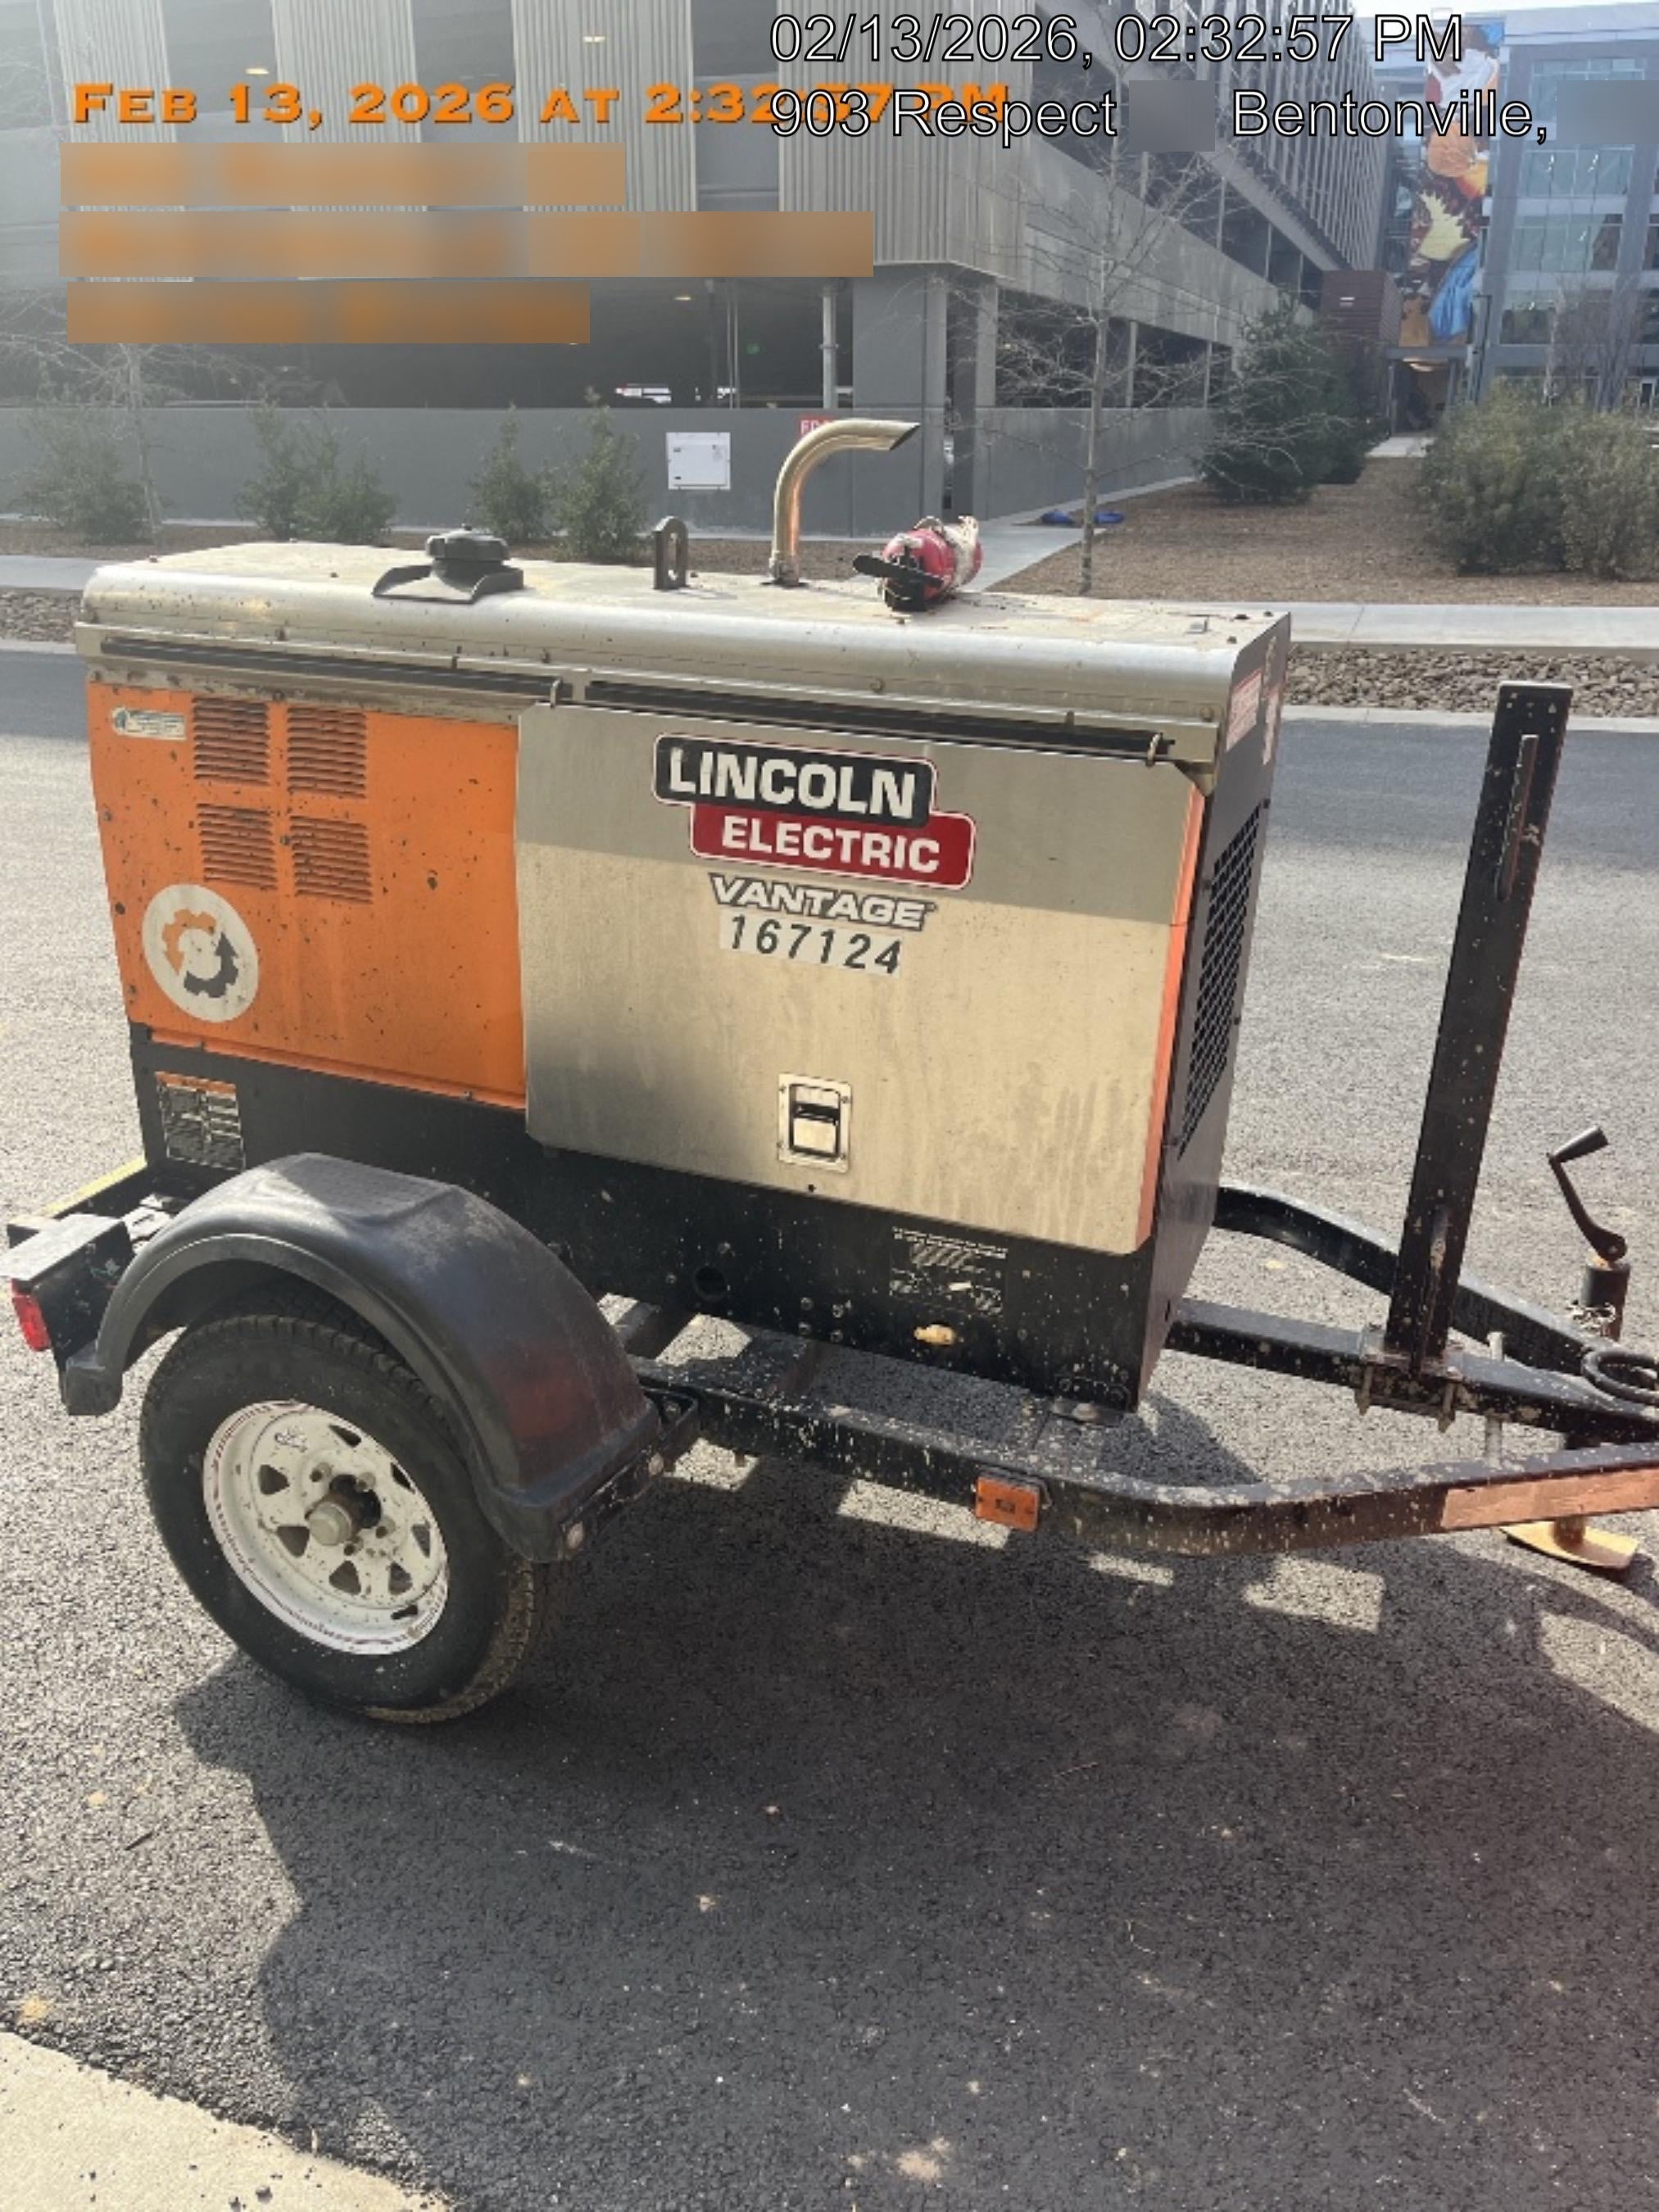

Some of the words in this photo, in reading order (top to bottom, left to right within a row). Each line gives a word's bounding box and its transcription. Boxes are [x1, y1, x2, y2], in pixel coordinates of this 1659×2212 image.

[669, 746, 916, 819] LINCOLN
[722, 815, 941, 873] ELECTRIC
[709, 873, 927, 931] VANTAGE
[730, 914, 902, 975] 167124
